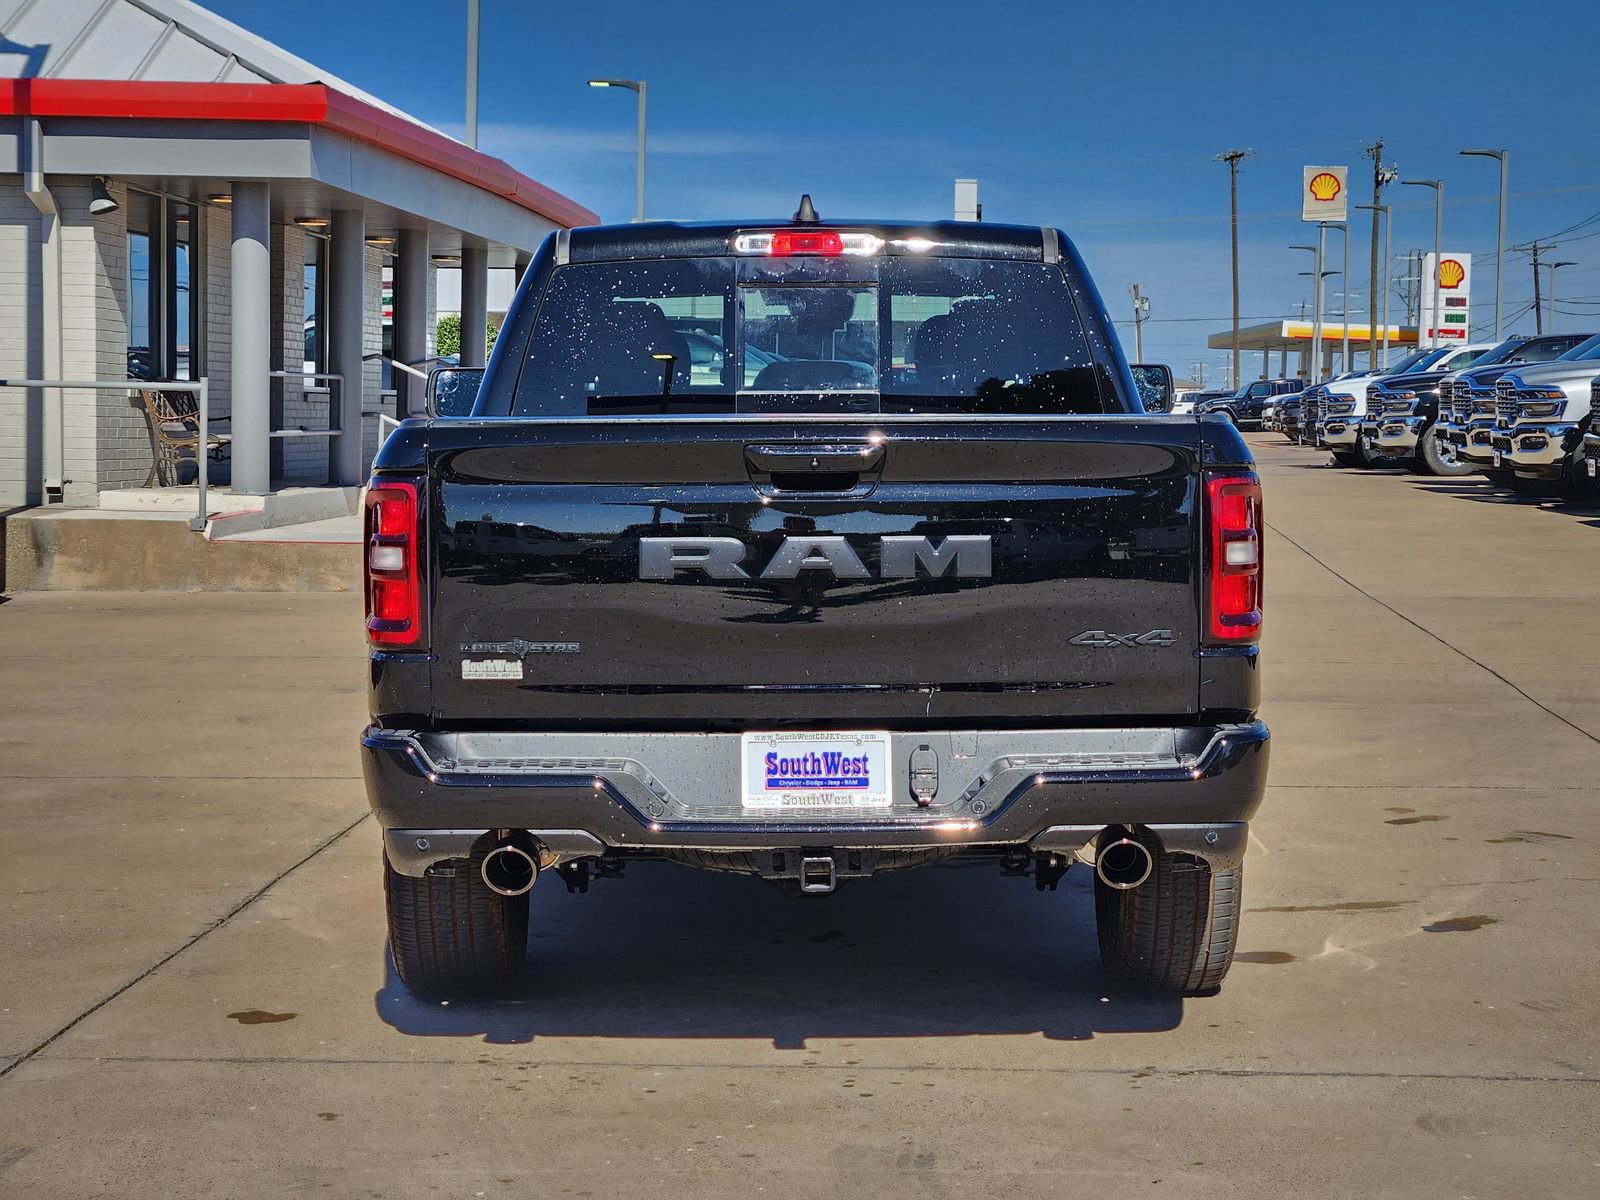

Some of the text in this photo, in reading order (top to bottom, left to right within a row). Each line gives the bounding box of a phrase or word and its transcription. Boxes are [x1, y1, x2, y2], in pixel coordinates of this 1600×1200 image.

[639, 535, 993, 579] RAM
[1066, 629, 1178, 647] 4x4
[460, 641, 581, 653] LONE STAR
[462, 659, 523, 672] SouthWest
[765, 752, 870, 777] SouthWest
[782, 793, 854, 805] SouthWest
